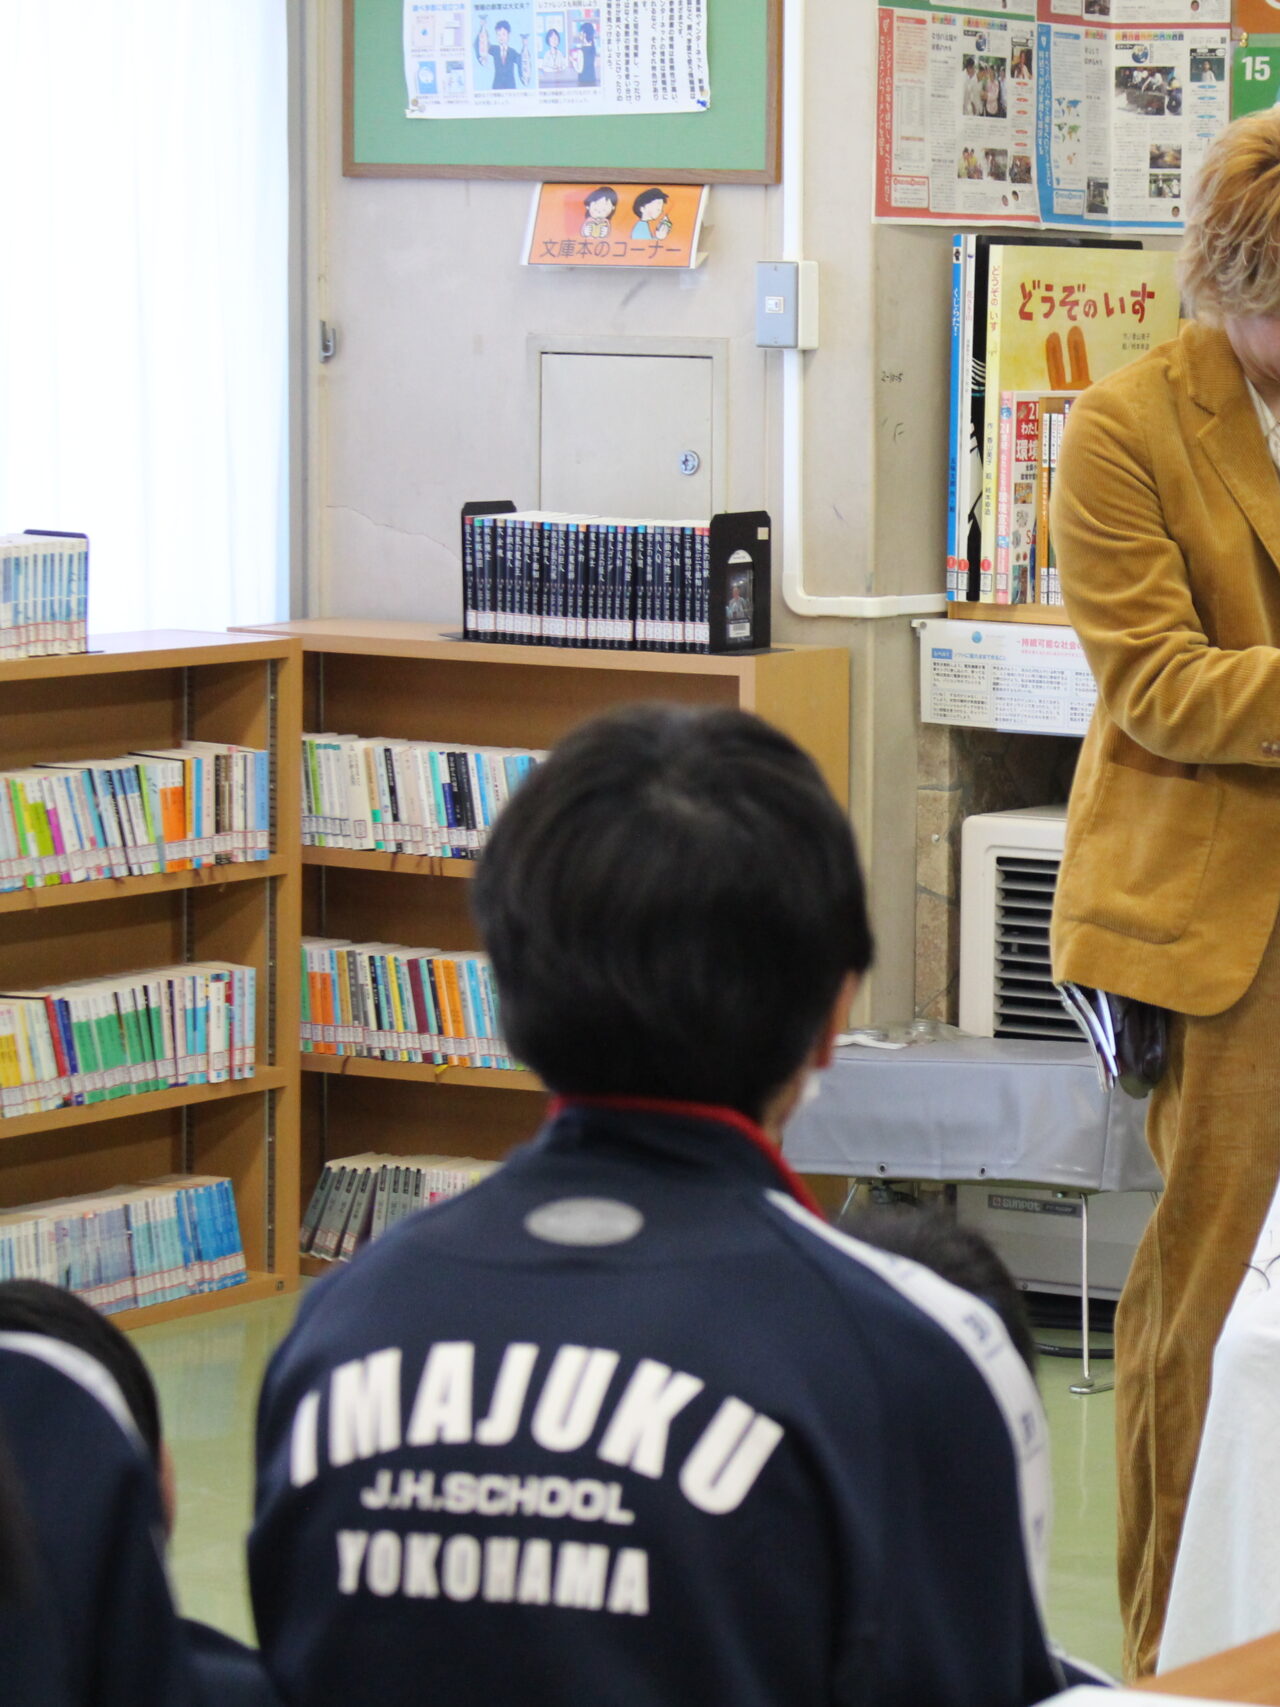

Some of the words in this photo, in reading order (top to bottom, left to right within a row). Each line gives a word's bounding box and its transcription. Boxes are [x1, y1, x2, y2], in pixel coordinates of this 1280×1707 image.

[1241, 56, 1271, 81] 15
[539, 238, 682, 260] 文庫本のコーナー
[1018, 278, 1156, 323] どうぞのいす
[290, 1341, 784, 1515] IMAJUKU
[360, 1468, 636, 1526] J.H.SCHOOL
[336, 1528, 651, 1617] YOKOHAMA
